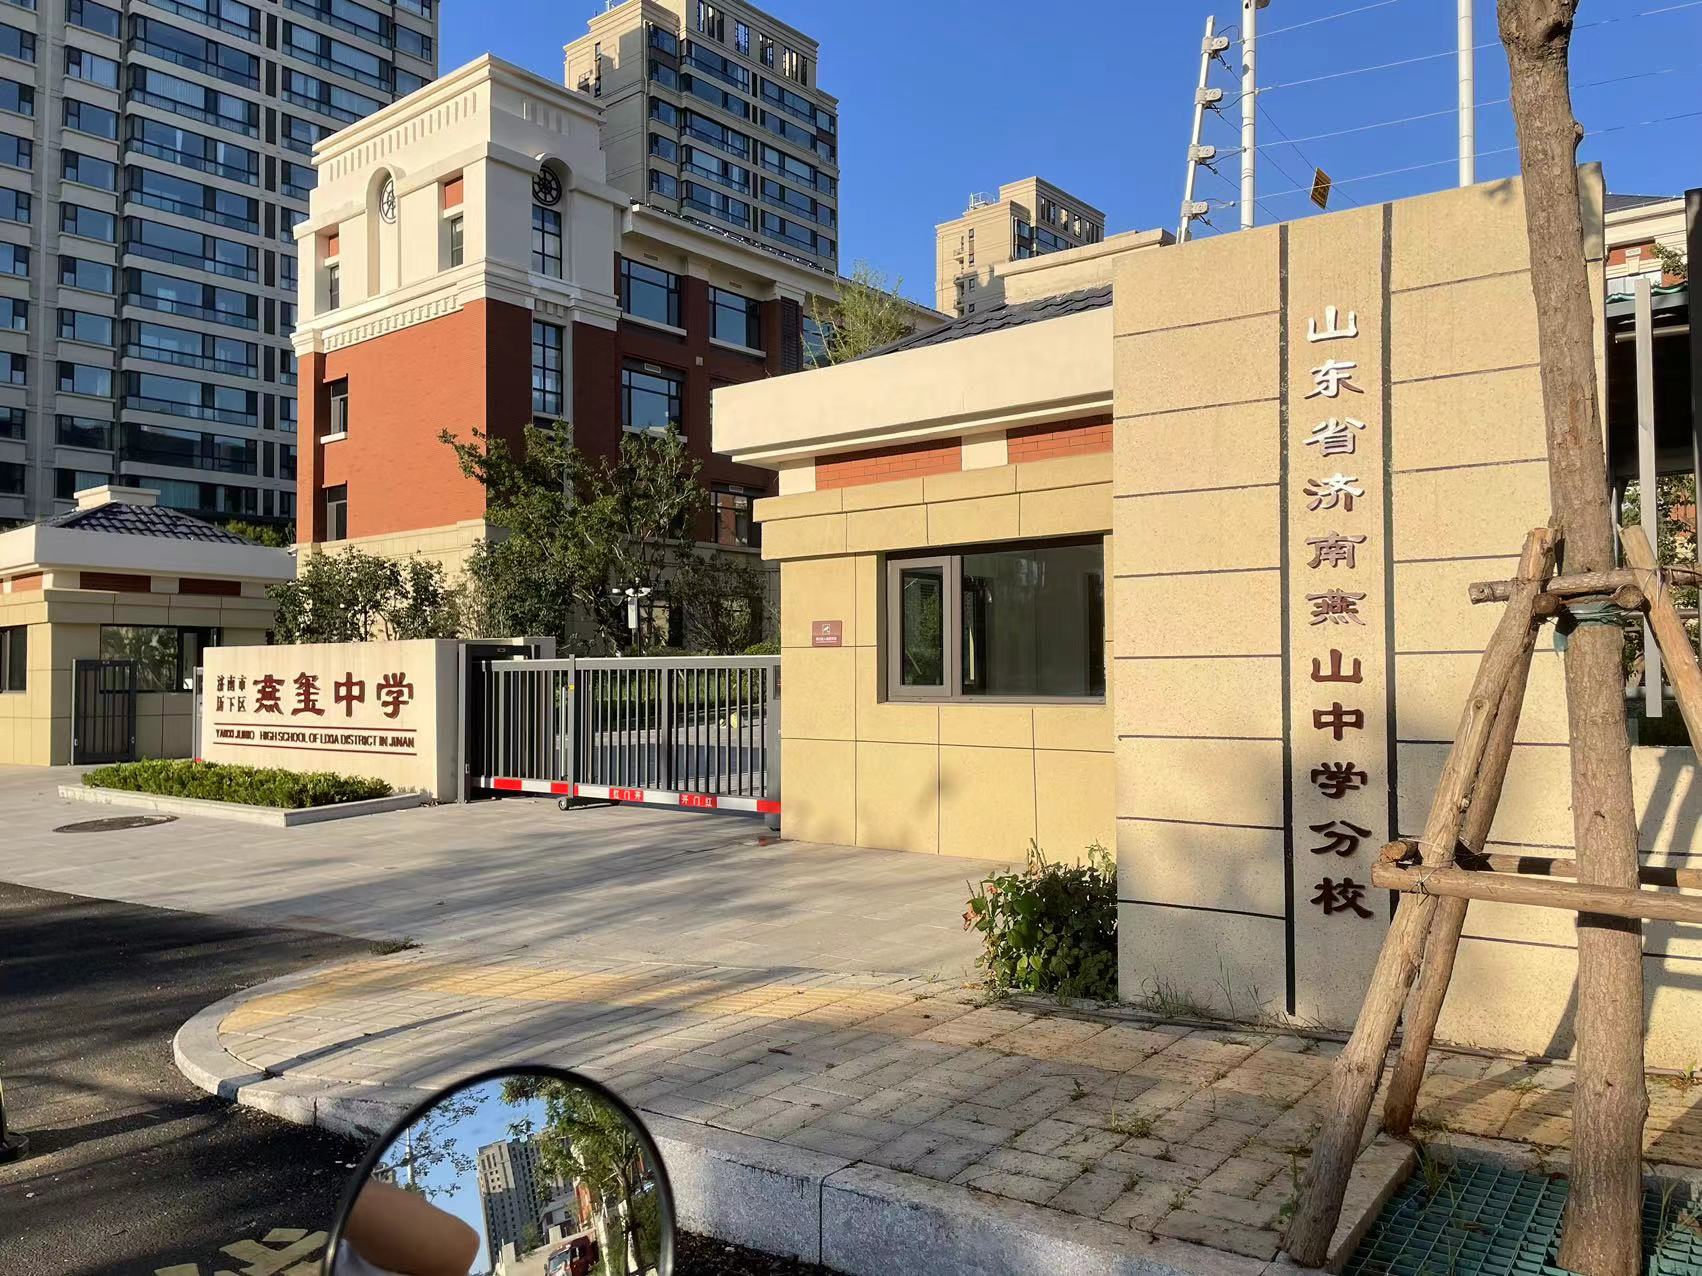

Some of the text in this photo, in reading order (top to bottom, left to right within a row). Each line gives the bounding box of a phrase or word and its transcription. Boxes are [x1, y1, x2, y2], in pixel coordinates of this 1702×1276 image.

[1303, 305, 1374, 919] 山东省济南燕山中学分校
[216, 674, 247, 692] 济南市
[216, 695, 247, 713] 历下区
[253, 672, 414, 719] 燕玺中学
[260, 731, 277, 741] HIGH
[278, 732, 308, 743] SCHOOL
[309, 733, 319, 743] OF
[320, 733, 339, 744] LIXIA
[340, 735, 377, 747] DISTRICT
[379, 736, 388, 746] IN
[389, 737, 414, 748] JINAN
[681, 794, 713, 807] 开门红
